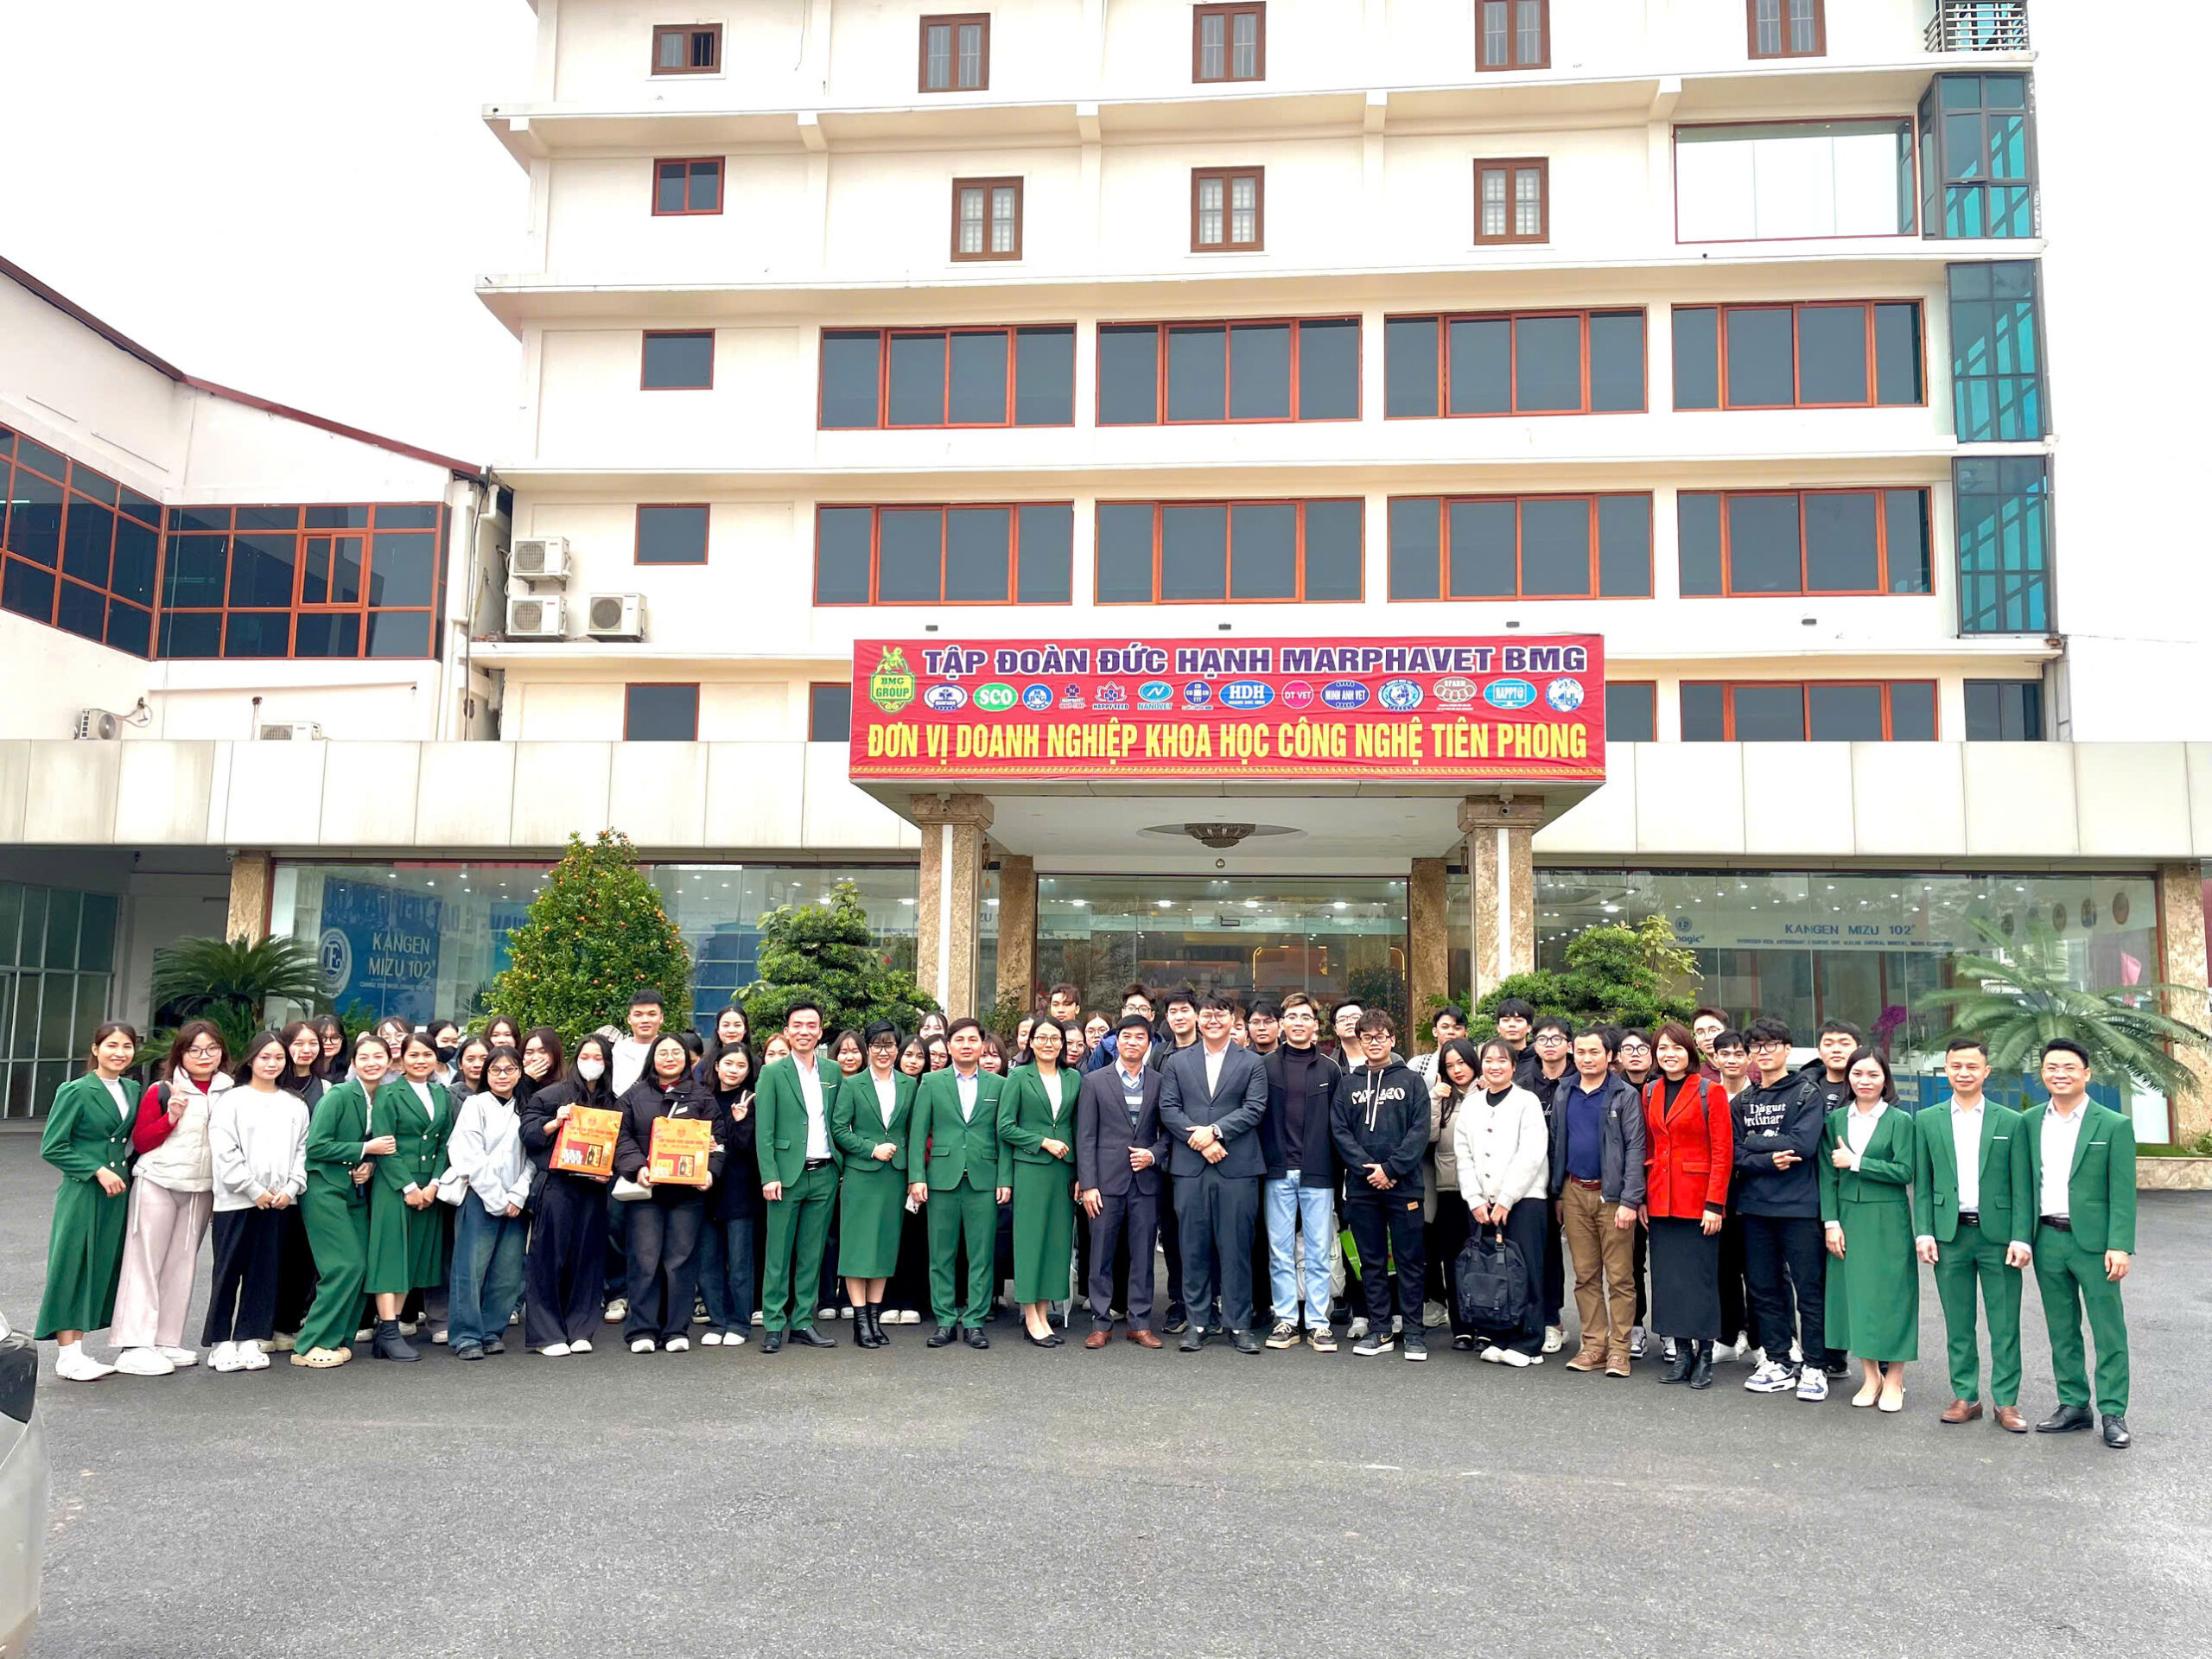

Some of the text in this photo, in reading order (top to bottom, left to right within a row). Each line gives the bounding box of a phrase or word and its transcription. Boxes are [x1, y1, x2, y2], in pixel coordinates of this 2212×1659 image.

[923, 643, 1587, 679] TẬP ĐOÀN ĐỨC HẠNH MARPHAVET BMG
[880, 677, 905, 685] BMG
[875, 687, 910, 698] GROUP
[979, 689, 1013, 705] SCO
[1229, 684, 1265, 699] HDH
[1285, 691, 1312, 700] DT VET
[1355, 690, 1366, 701] VET
[868, 716, 1587, 766] ĐƠN VỊ DOANH NGHIỆP KHOA HỌC CÔNG NGHỆ TIÊN PHONG
[1784, 924, 1840, 935] KANGEN
[1847, 925, 1880, 935] MIZU
[373, 932, 430, 955] KANGEN
[368, 957, 404, 977] MIZU
